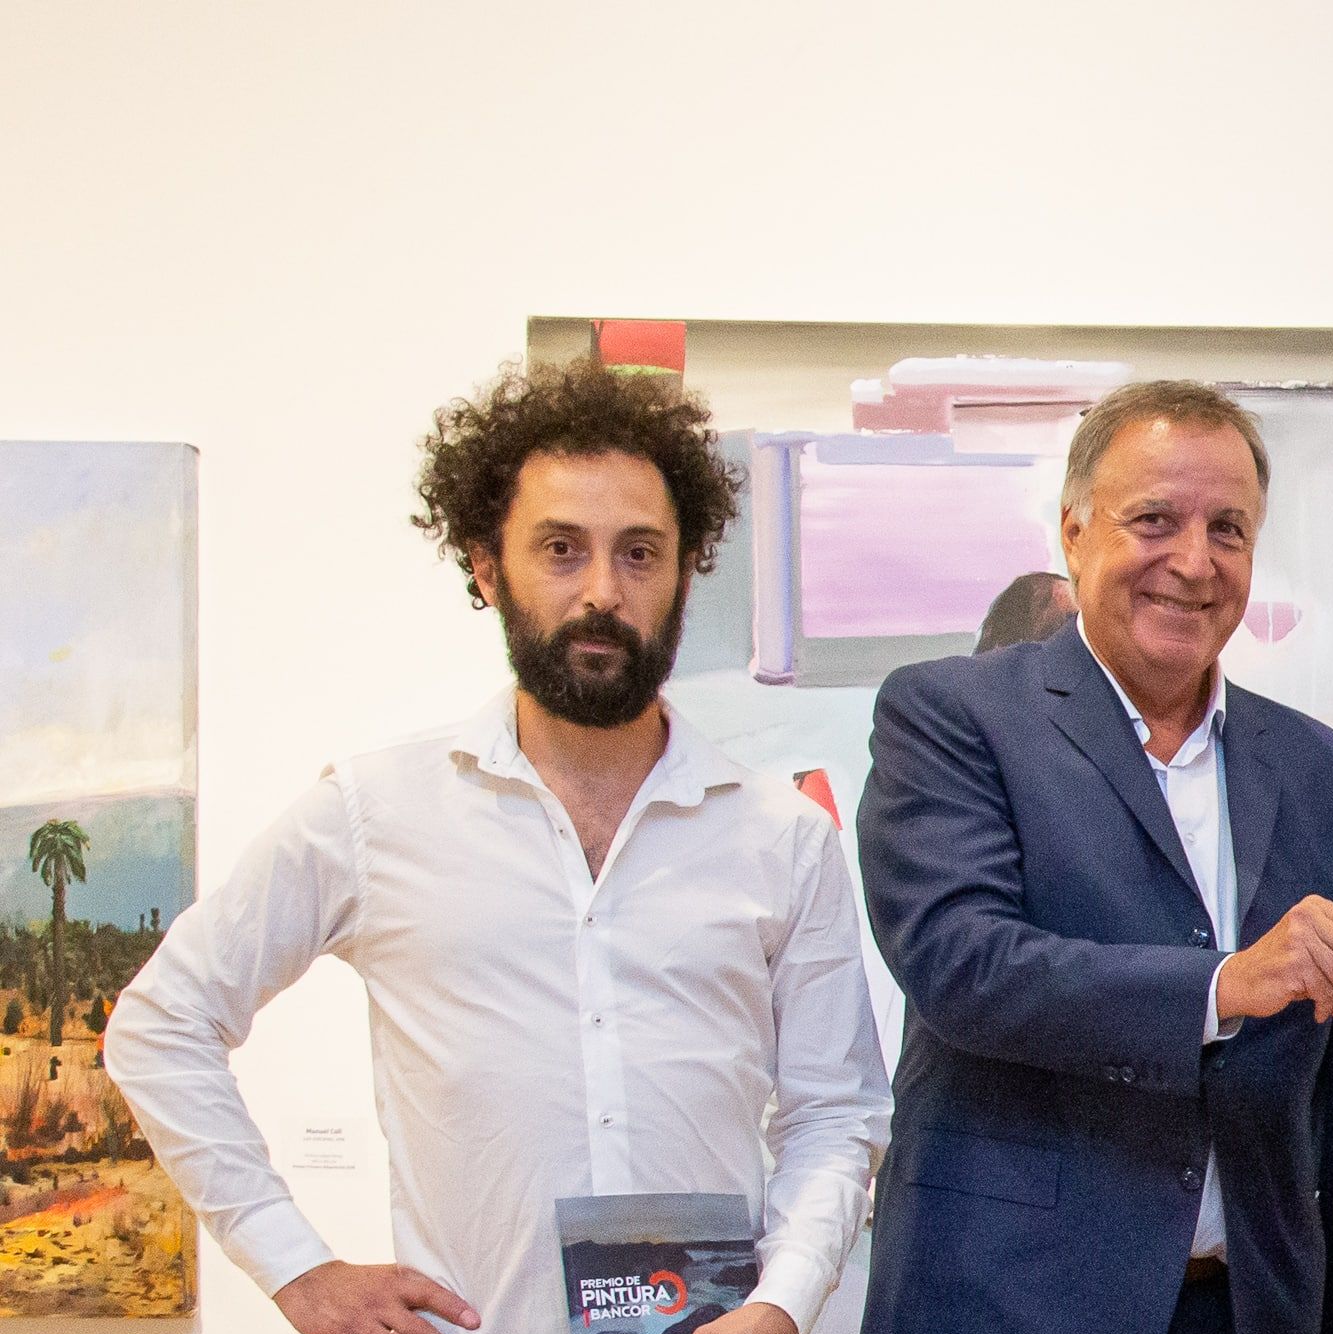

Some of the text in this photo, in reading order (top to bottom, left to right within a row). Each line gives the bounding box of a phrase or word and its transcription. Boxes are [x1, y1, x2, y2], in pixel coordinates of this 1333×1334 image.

[580, 1275, 641, 1289] PREMIO DE
[582, 1284, 671, 1307] PINTURA
[590, 1304, 651, 1320] BANCOR
